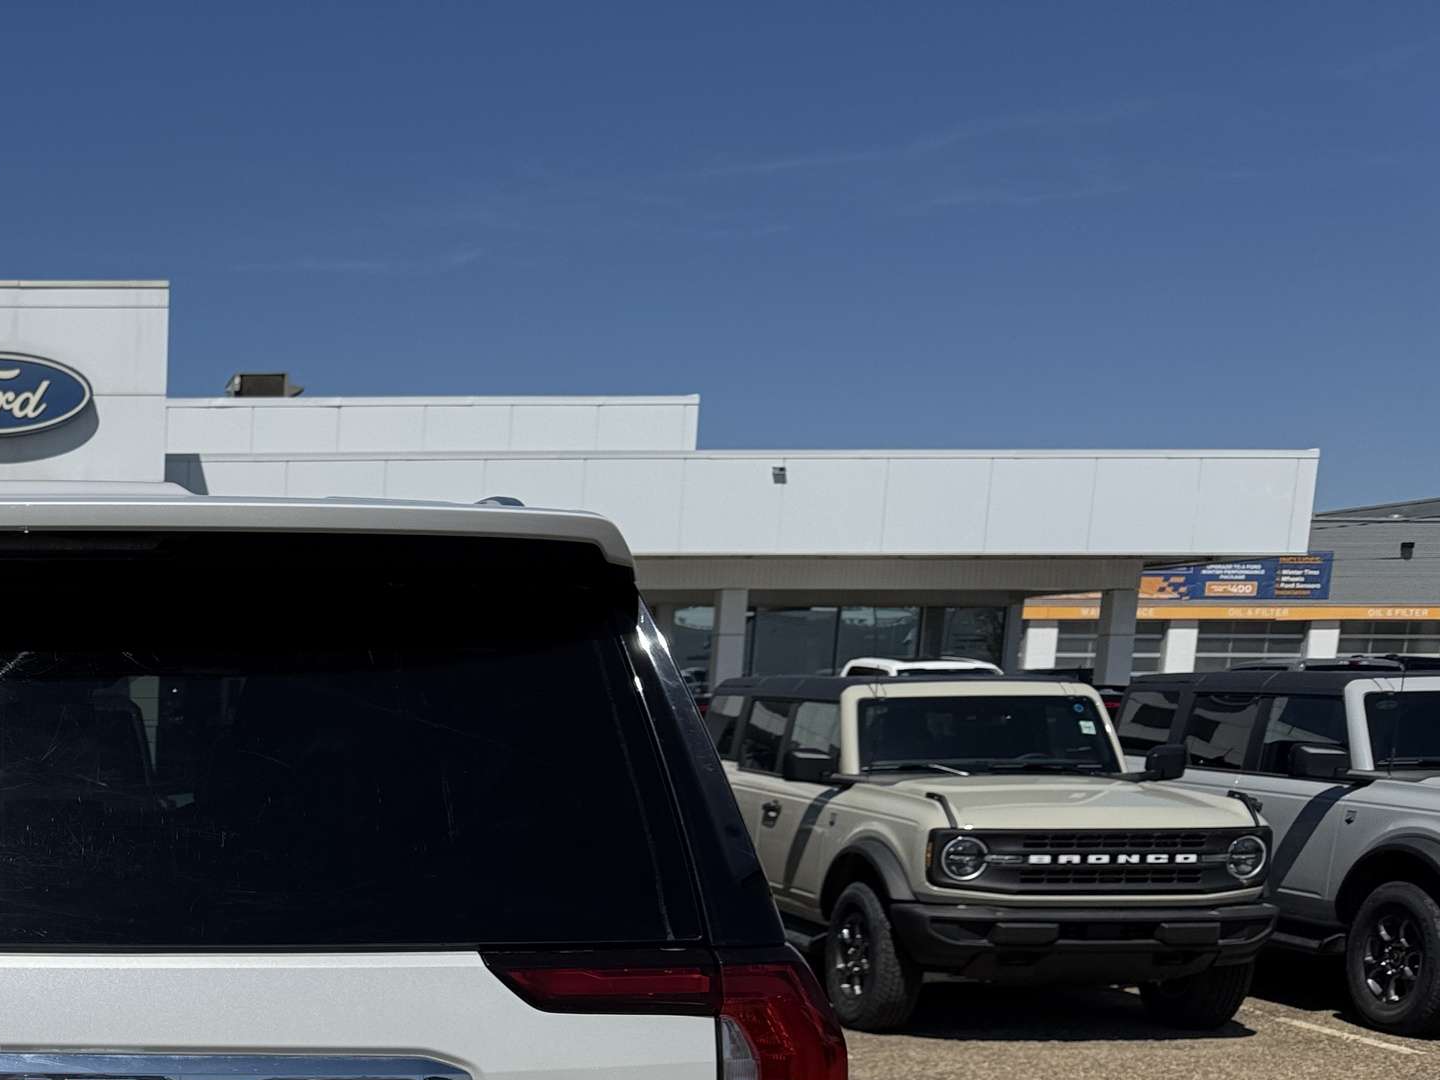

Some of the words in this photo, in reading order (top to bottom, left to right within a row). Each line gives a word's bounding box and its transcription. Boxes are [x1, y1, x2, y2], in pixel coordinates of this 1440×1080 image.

[1228, 607, 1244, 617] OIL
[1255, 607, 1289, 617] FILTER
[1368, 607, 1384, 617] OIL
[1395, 607, 1429, 617] FILTER
[1028, 853, 1198, 865] BRONCO
